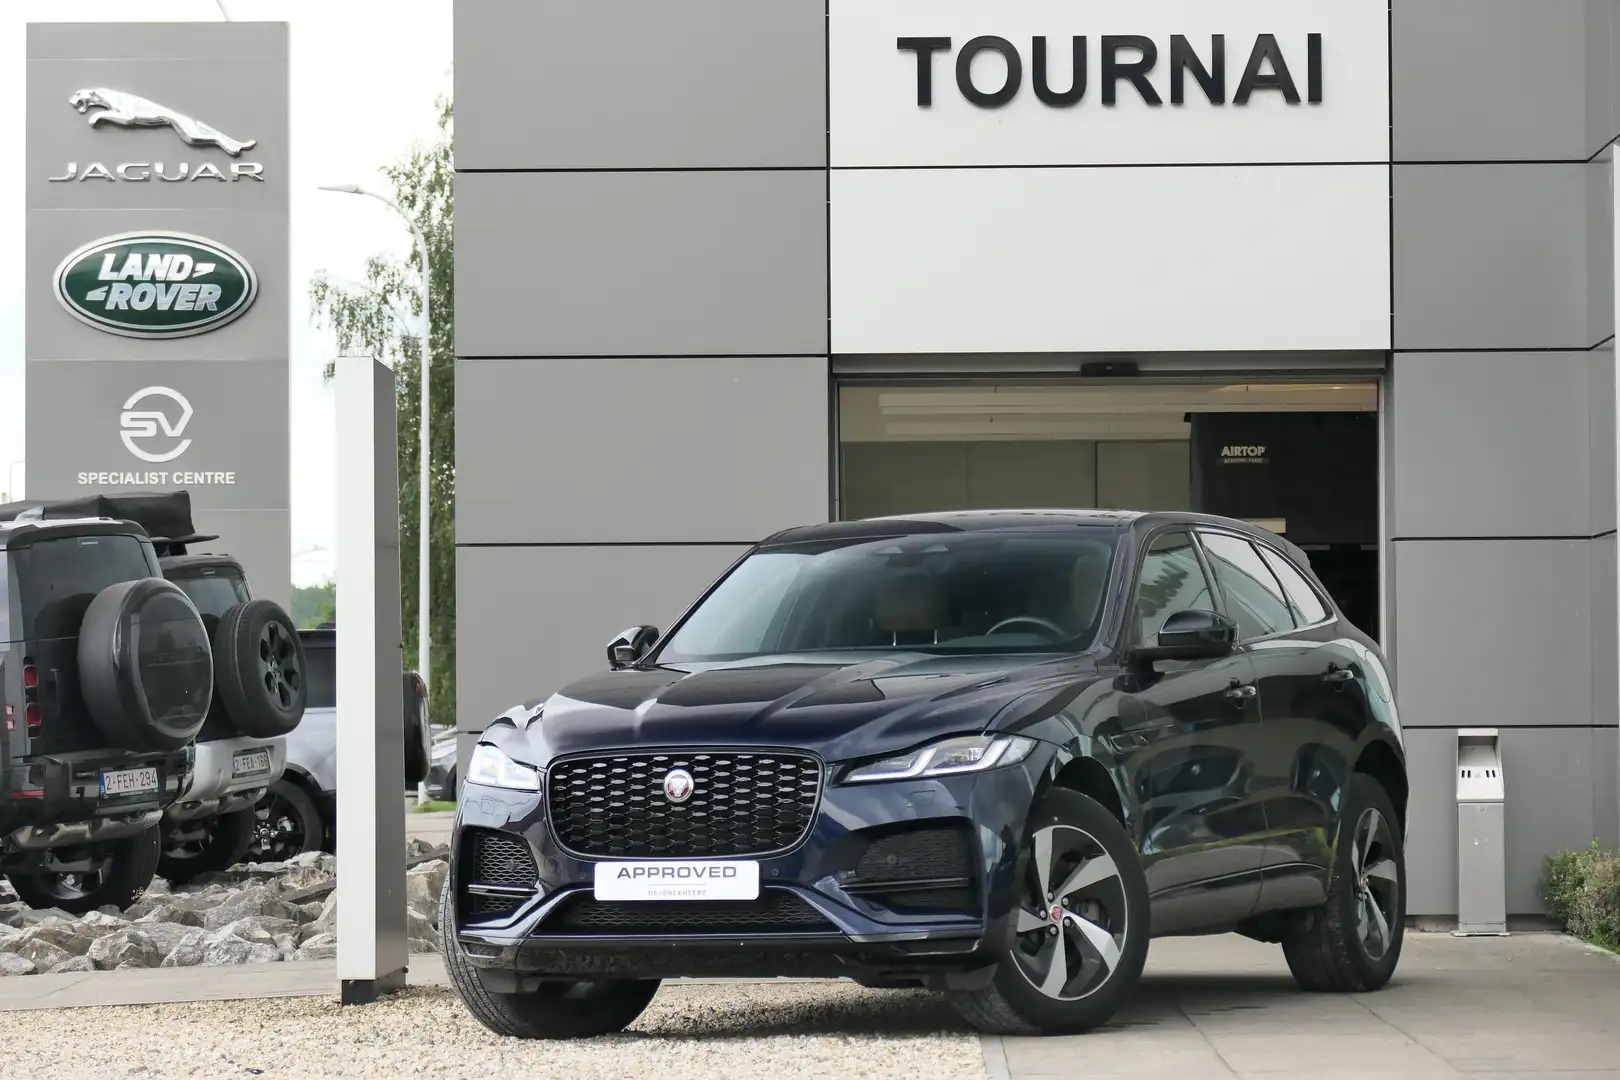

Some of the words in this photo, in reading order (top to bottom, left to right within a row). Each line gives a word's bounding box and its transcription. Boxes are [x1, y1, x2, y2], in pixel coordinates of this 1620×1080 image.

[897, 33, 1322, 107] TOURNAI
[48, 161, 265, 182] JAGUAR
[98, 253, 194, 281] LAND
[105, 282, 222, 311] ROVER
[1221, 446, 1266, 457] AIRTOP
[77, 471, 168, 485] SPECIALIST
[172, 471, 236, 485] CENTRE
[105, 770, 157, 791] 2-FEH-294
[617, 866, 737, 879] APPROVED
